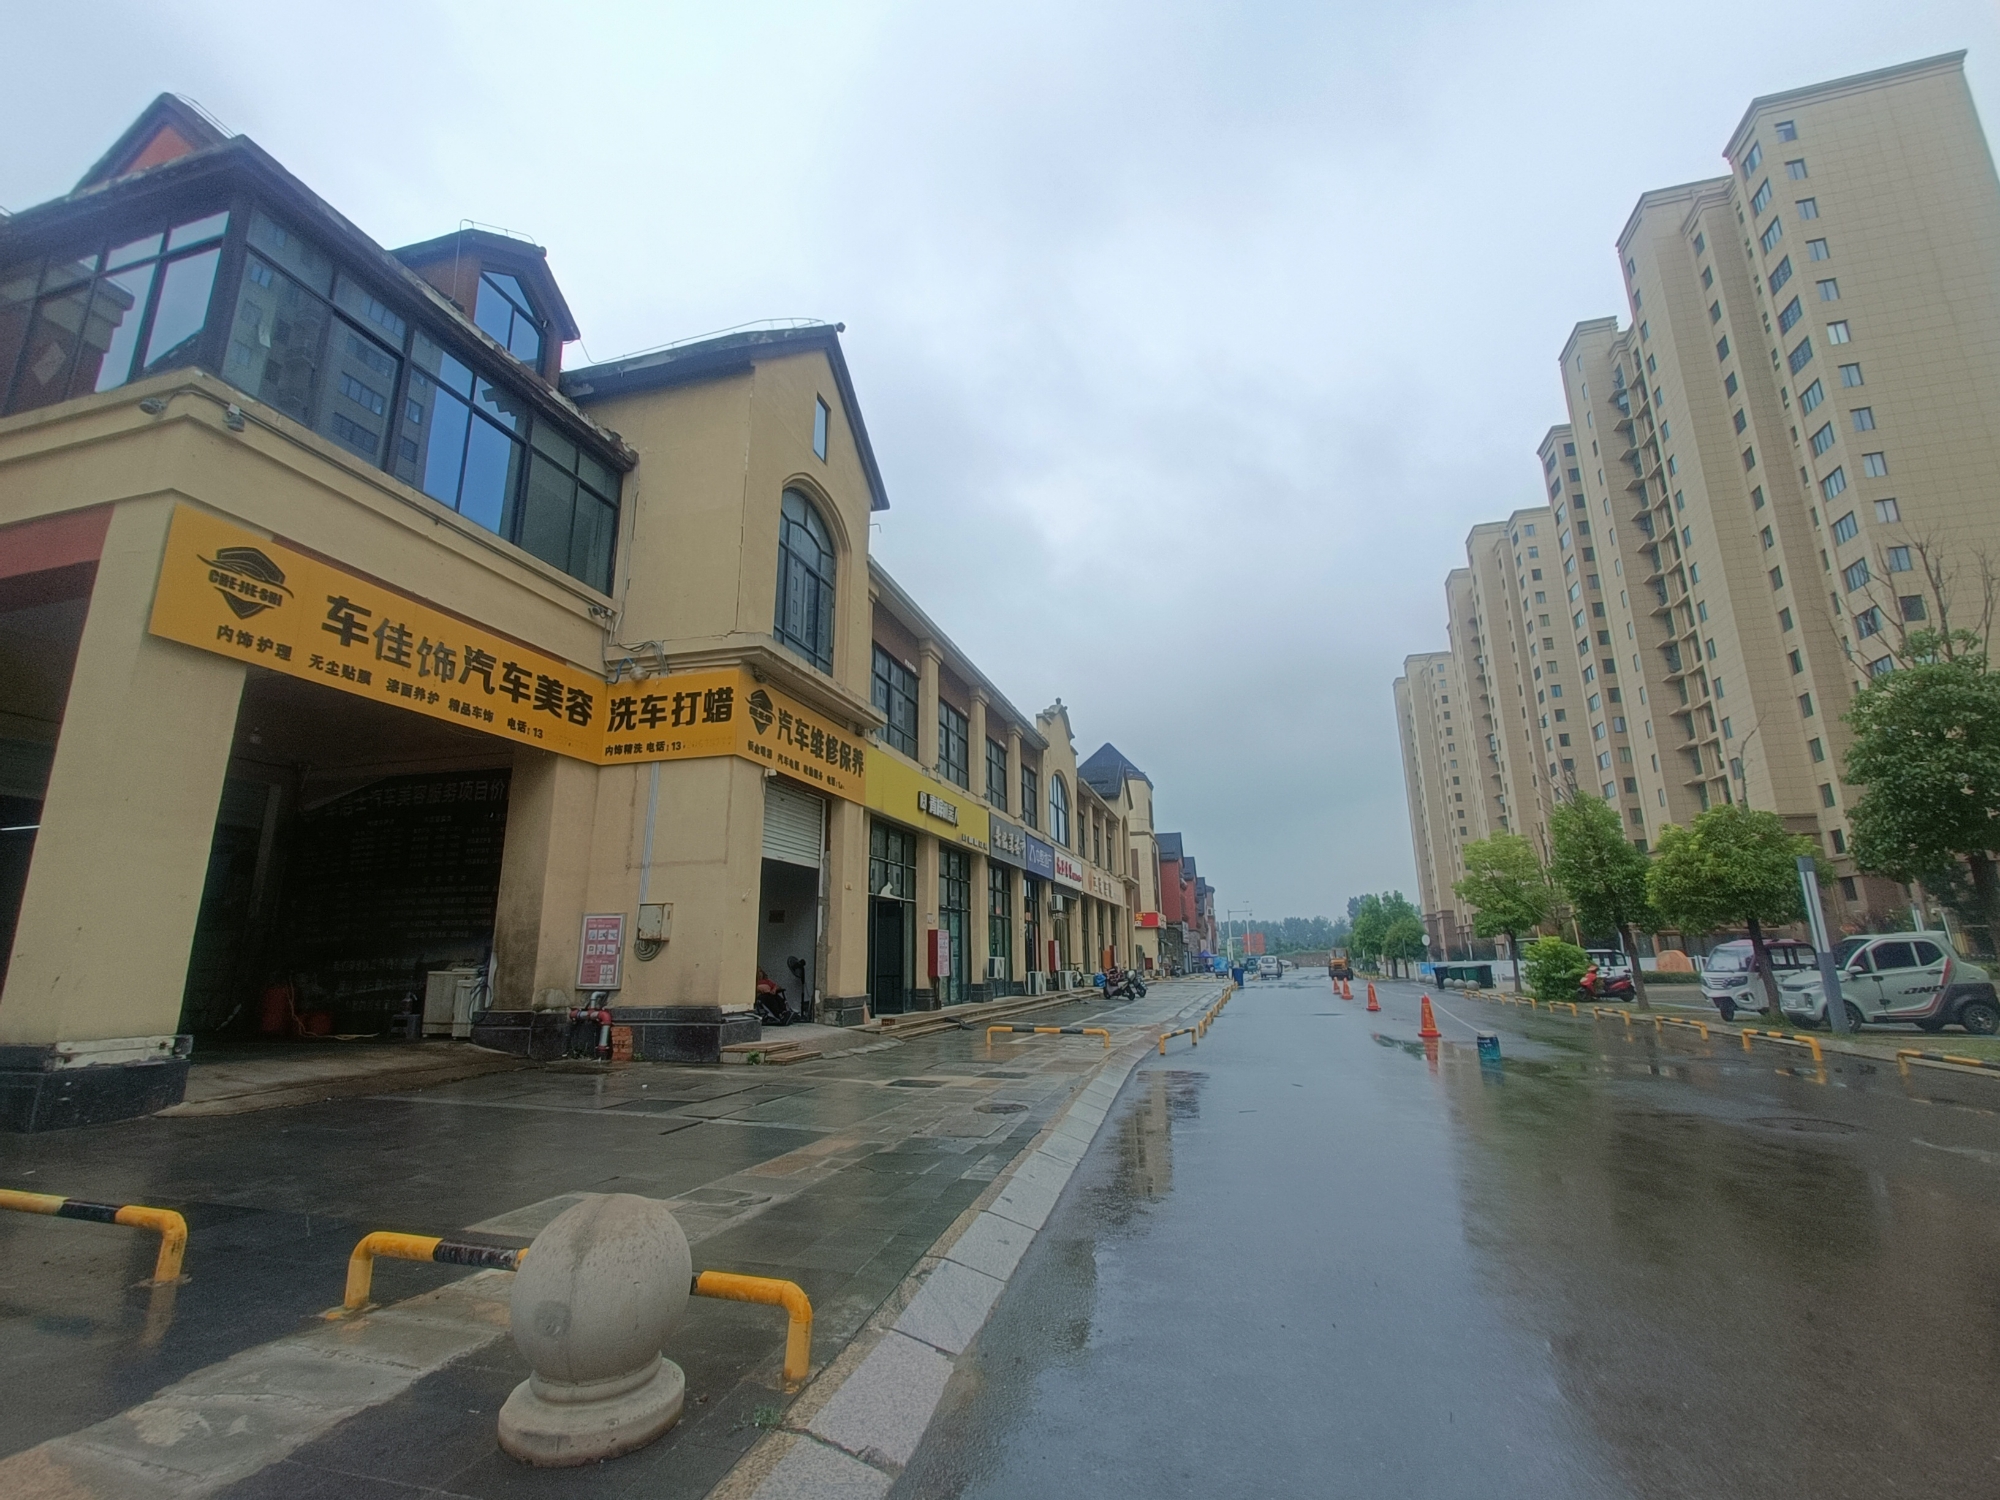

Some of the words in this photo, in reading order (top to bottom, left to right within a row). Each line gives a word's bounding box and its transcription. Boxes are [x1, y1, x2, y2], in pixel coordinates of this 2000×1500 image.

[216, 625, 293, 662] 内饰护理
[308, 653, 373, 686] 无尘贴膜
[385, 677, 440, 705] 漆面养护
[448, 697, 495, 723] 精品车饰
[321, 596, 594, 726] 车佳饰汽车美容
[607, 686, 734, 732] 洗车打蜡
[604, 742, 643, 757] 内饰精洗
[777, 707, 865, 778] 汽车维修保养
[370, 778, 510, 808] 汽车美容服务项目价
